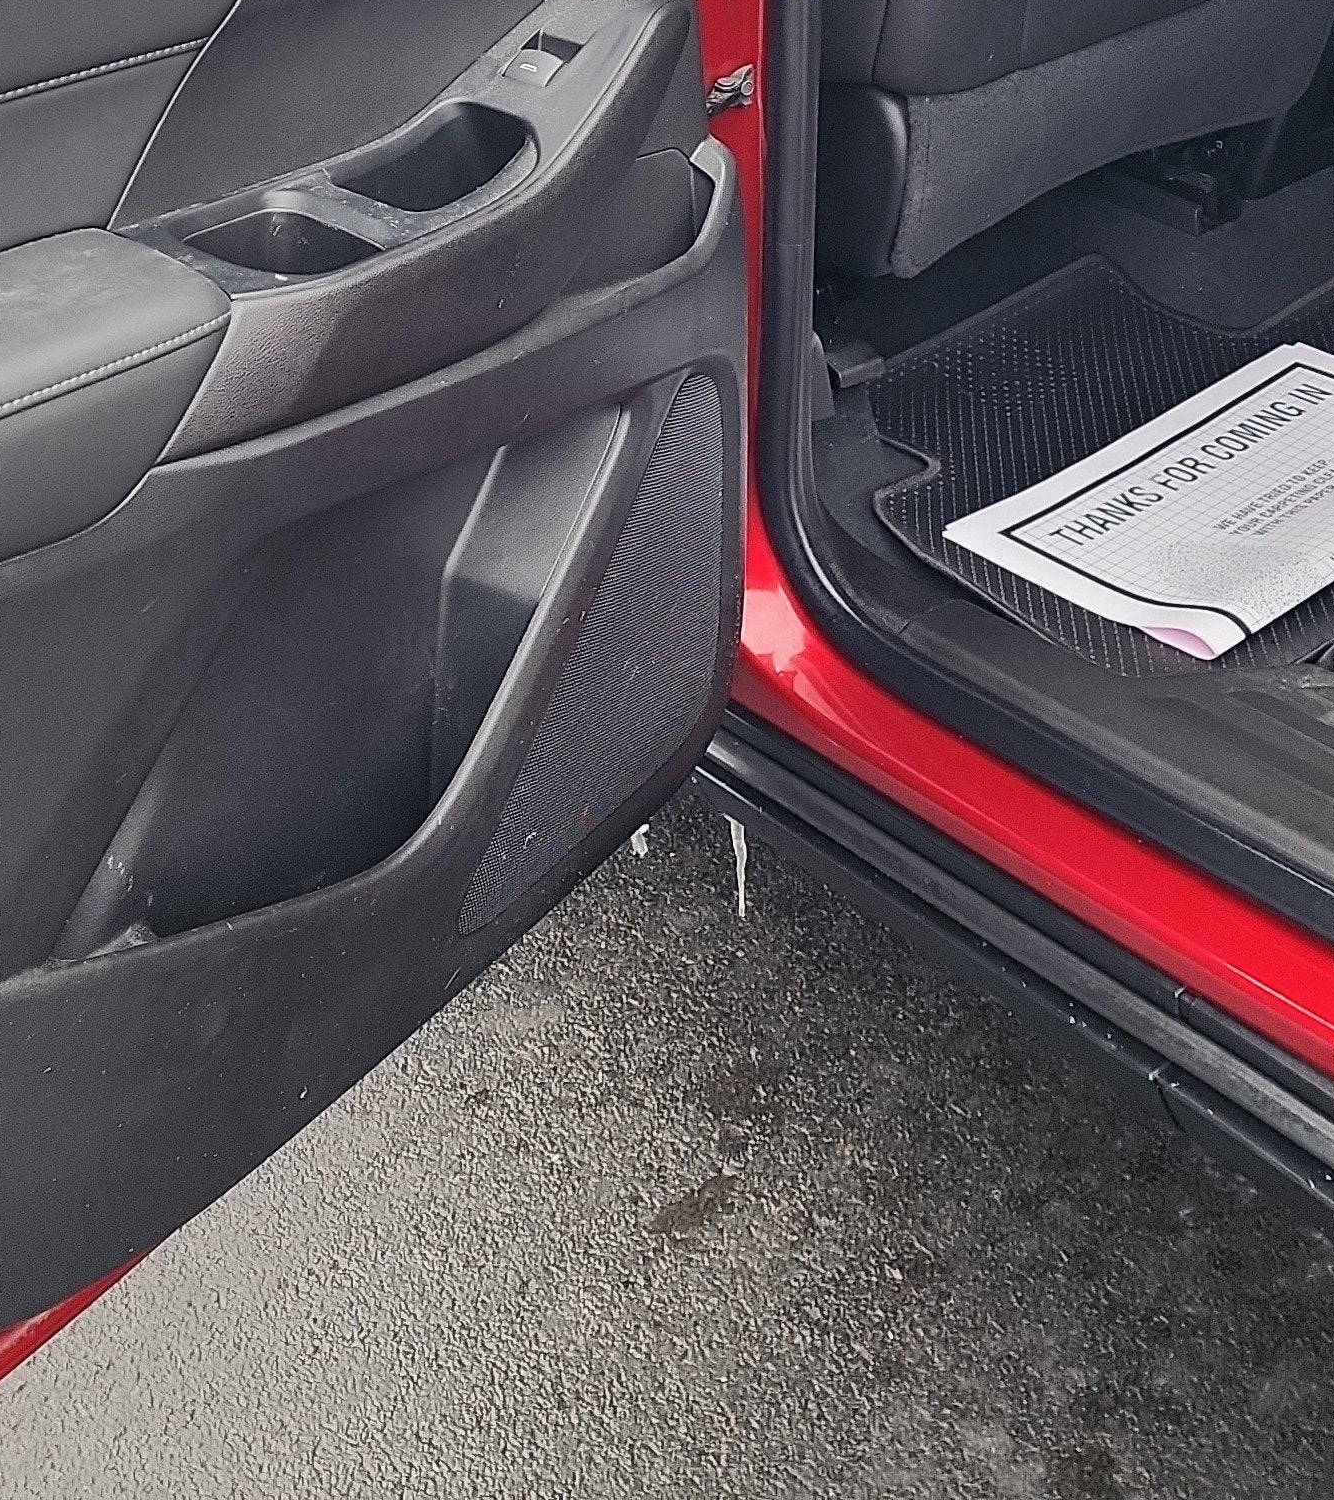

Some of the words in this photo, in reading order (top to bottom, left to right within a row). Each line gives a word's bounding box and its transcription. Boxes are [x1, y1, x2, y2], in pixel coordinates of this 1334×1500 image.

[1049, 486, 1164, 546] THANKS
[1151, 456, 1217, 491] FOR
[1201, 401, 1307, 461] COMING
[1288, 383, 1334, 406] IN
[1214, 517, 1236, 530] WE
[1232, 501, 1263, 520] HAVE
[1258, 484, 1292, 503] TRIED
[1286, 474, 1306, 485] TO
[1301, 459, 1328, 476] KEEP
[1229, 516, 1265, 536] YOUR
[1260, 483, 1318, 518] CARPETING
[1252, 518, 1285, 536] WITH
[1279, 504, 1308, 518] THIS
